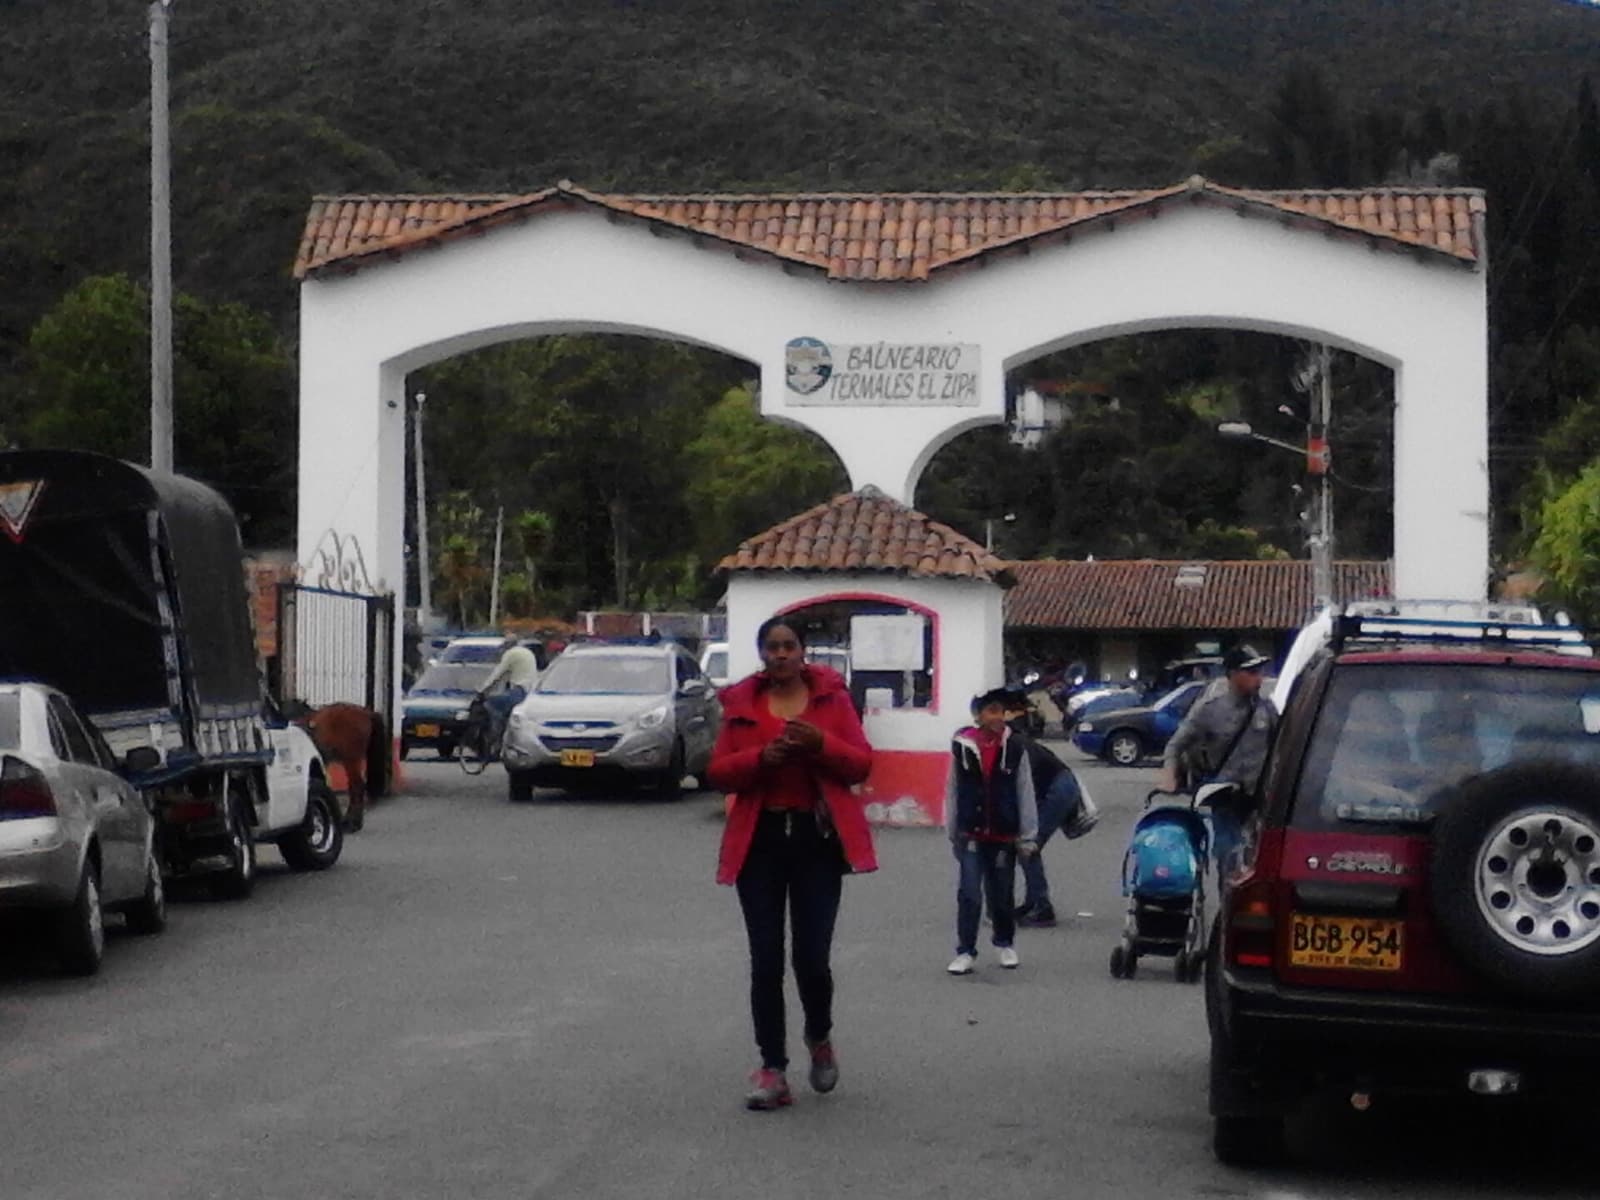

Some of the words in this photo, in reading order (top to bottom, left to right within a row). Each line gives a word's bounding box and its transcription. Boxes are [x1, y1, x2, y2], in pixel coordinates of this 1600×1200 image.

[847, 346, 961, 370] BALNEARIO
[830, 373, 914, 400] TERMALES
[918, 373, 936, 399] EL
[941, 374, 977, 399] ZIPA
